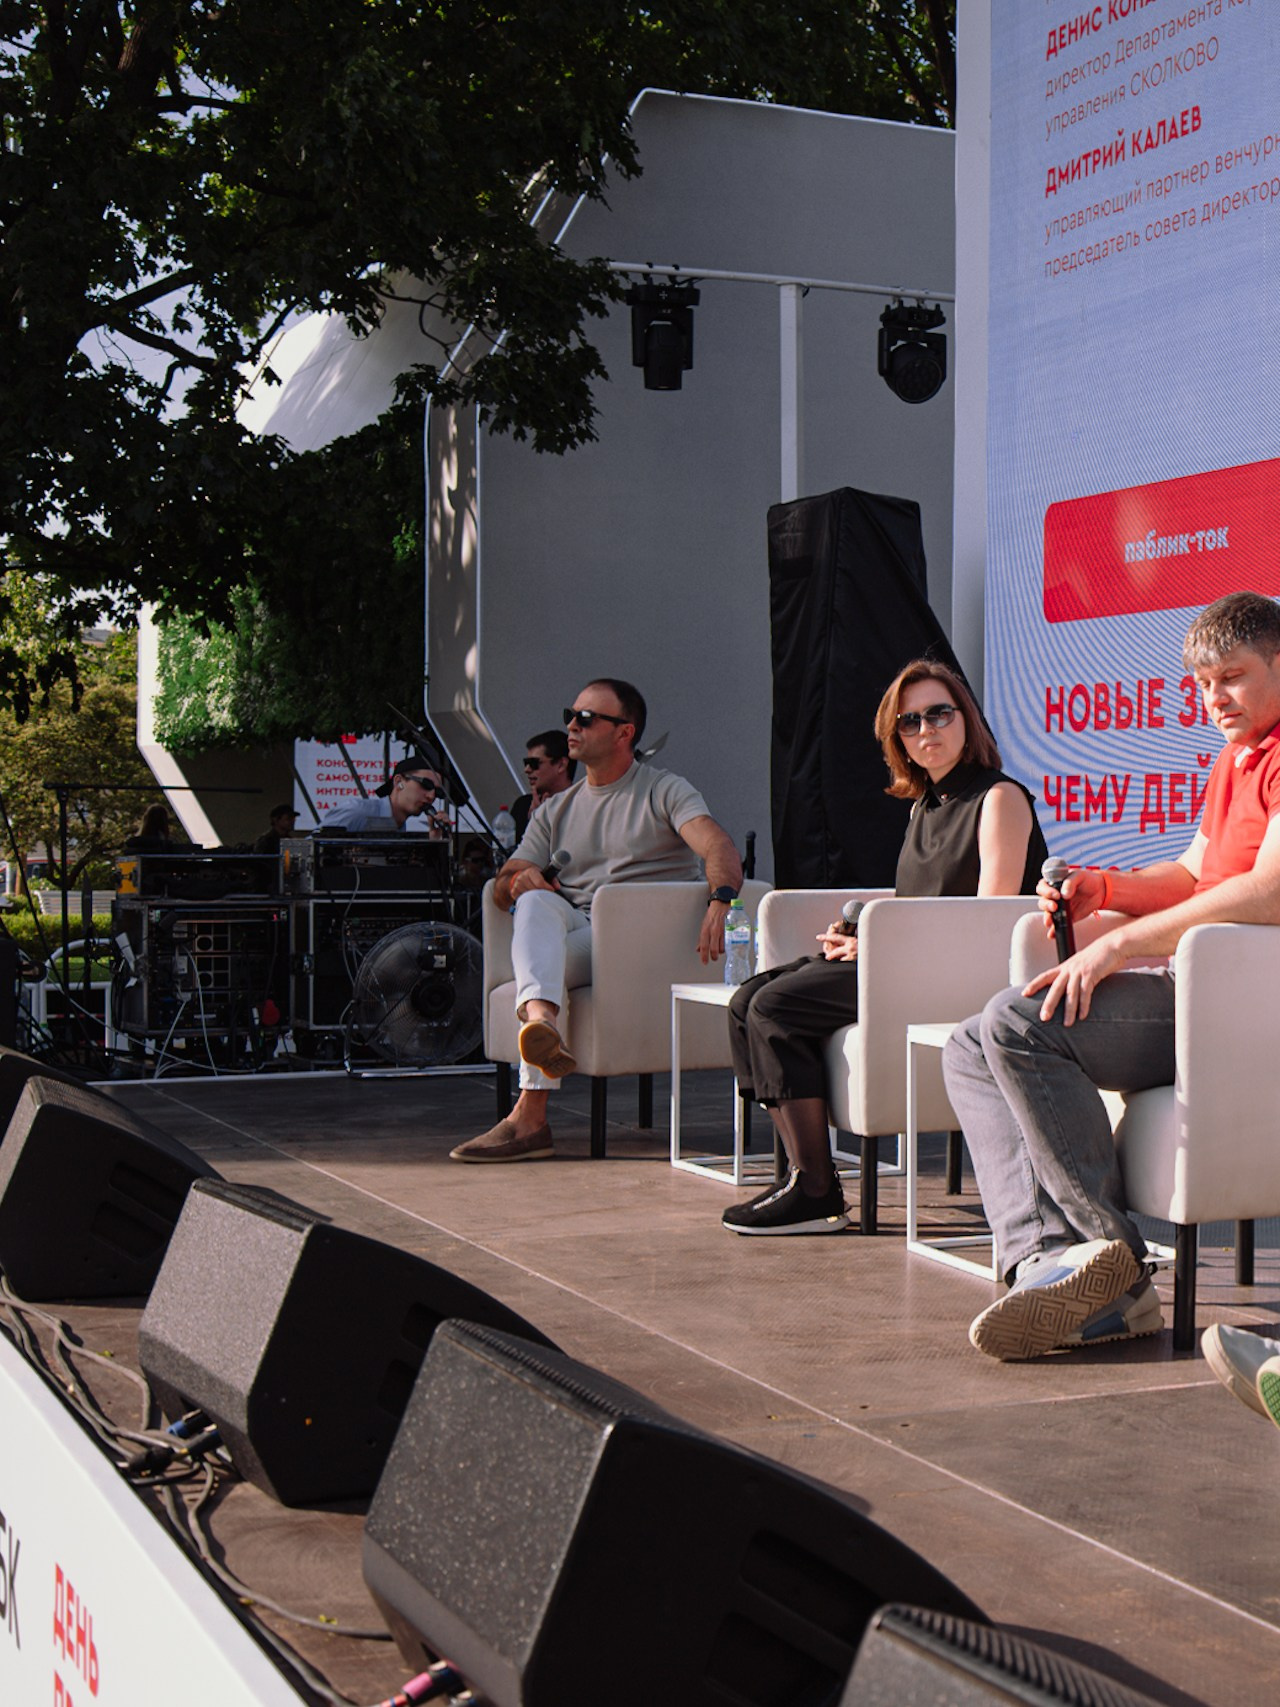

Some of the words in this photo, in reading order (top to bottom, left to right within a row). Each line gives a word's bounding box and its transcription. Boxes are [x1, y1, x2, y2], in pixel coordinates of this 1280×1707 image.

[1046, 6, 1102, 61] ДЕНИС
[1046, 51, 1111, 99] директор
[1115, 0, 1222, 67] Департамента
[1046, 84, 1125, 142] управления
[1131, 36, 1219, 96] СКОЛКОВО
[1046, 128, 1125, 198] ДМИТРИЙ
[1132, 105, 1202, 157] КАЛАЕВ
[1045, 181, 1141, 245] управляющий
[1146, 160, 1209, 200] партнер
[1045, 230, 1140, 277] председатель
[1145, 208, 1196, 242] совета
[1124, 526, 1229, 563] паблик-ток
[1045, 678, 1164, 733] НОВЫЕ
[1044, 774, 1131, 823] ЧЕМУ
[53, 1562, 98, 1698] ДЕНЬ
